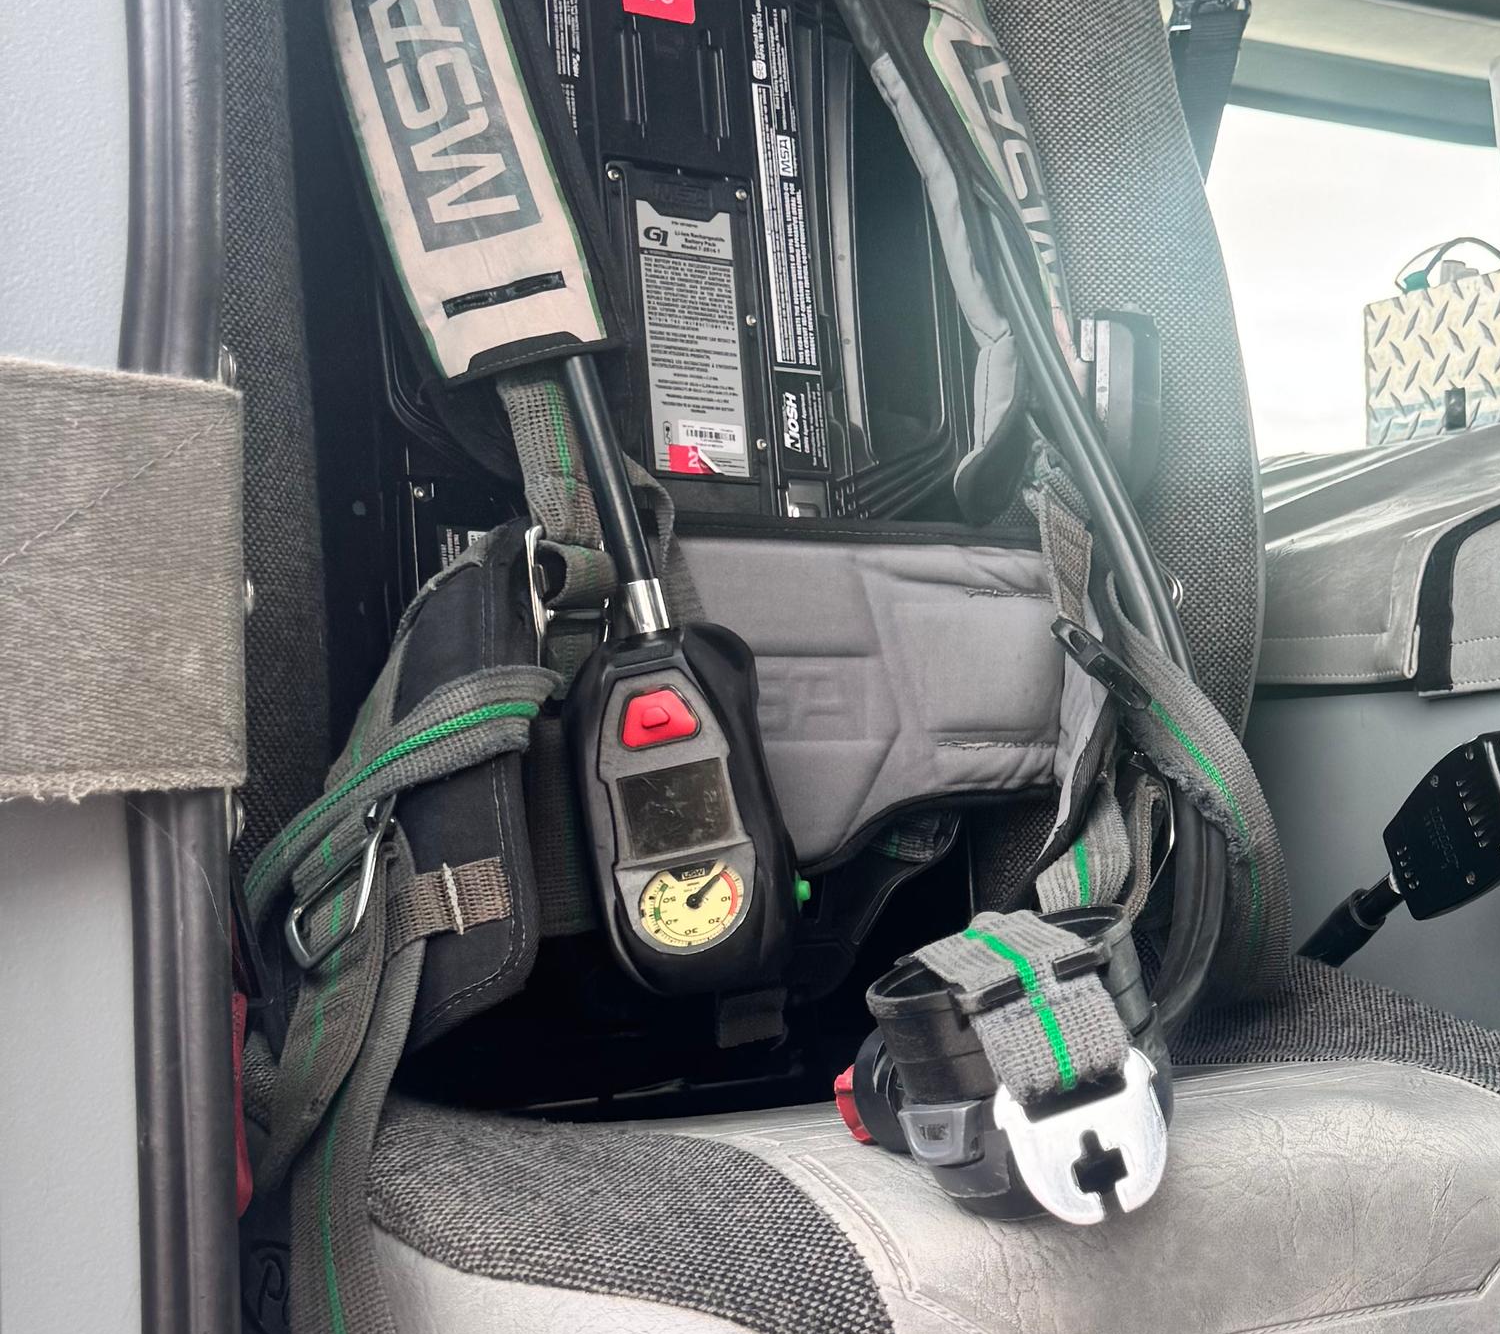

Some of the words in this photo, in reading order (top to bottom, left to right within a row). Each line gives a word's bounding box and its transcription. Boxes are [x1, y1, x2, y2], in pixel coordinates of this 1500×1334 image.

[780, 139, 790, 173] MSA
[643, 226, 668, 247] G1
[784, 391, 801, 453] NIOSH
